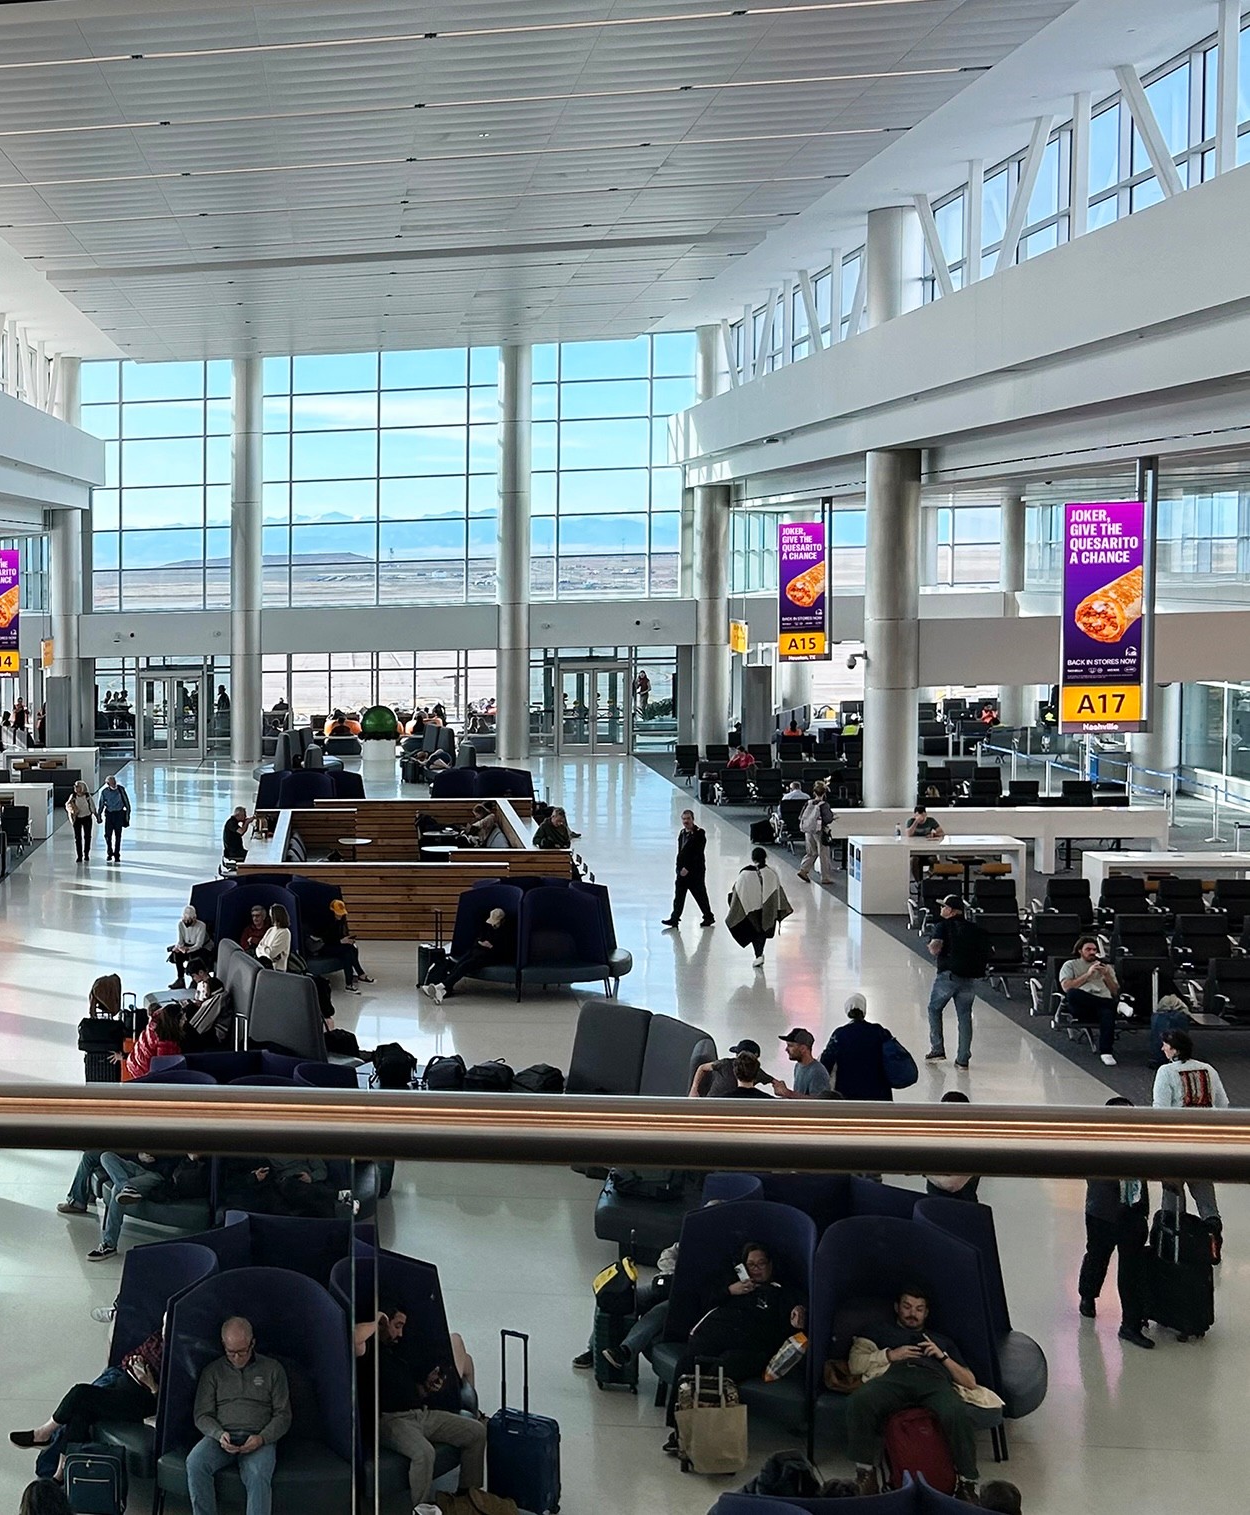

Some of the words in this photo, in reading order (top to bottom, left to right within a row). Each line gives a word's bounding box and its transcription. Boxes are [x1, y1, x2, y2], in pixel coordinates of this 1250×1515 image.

[1070, 510, 1110, 522] JOKER,
[782, 528, 806, 536] JOKER,
[1070, 524, 1097, 536] GIVE
[1100, 522, 1122, 535] THE
[782, 544, 822, 553] QUESARITO
[1070, 537, 1138, 552] QUESARITO
[782, 552, 787, 560] A
[789, 552, 817, 560] CHANCE
[1070, 551, 1078, 564] A
[1082, 551, 1129, 564] CHANCE
[788, 638, 815, 650] A15
[1078, 694, 1125, 713] A17
[1083, 723, 1119, 731] Nashville
